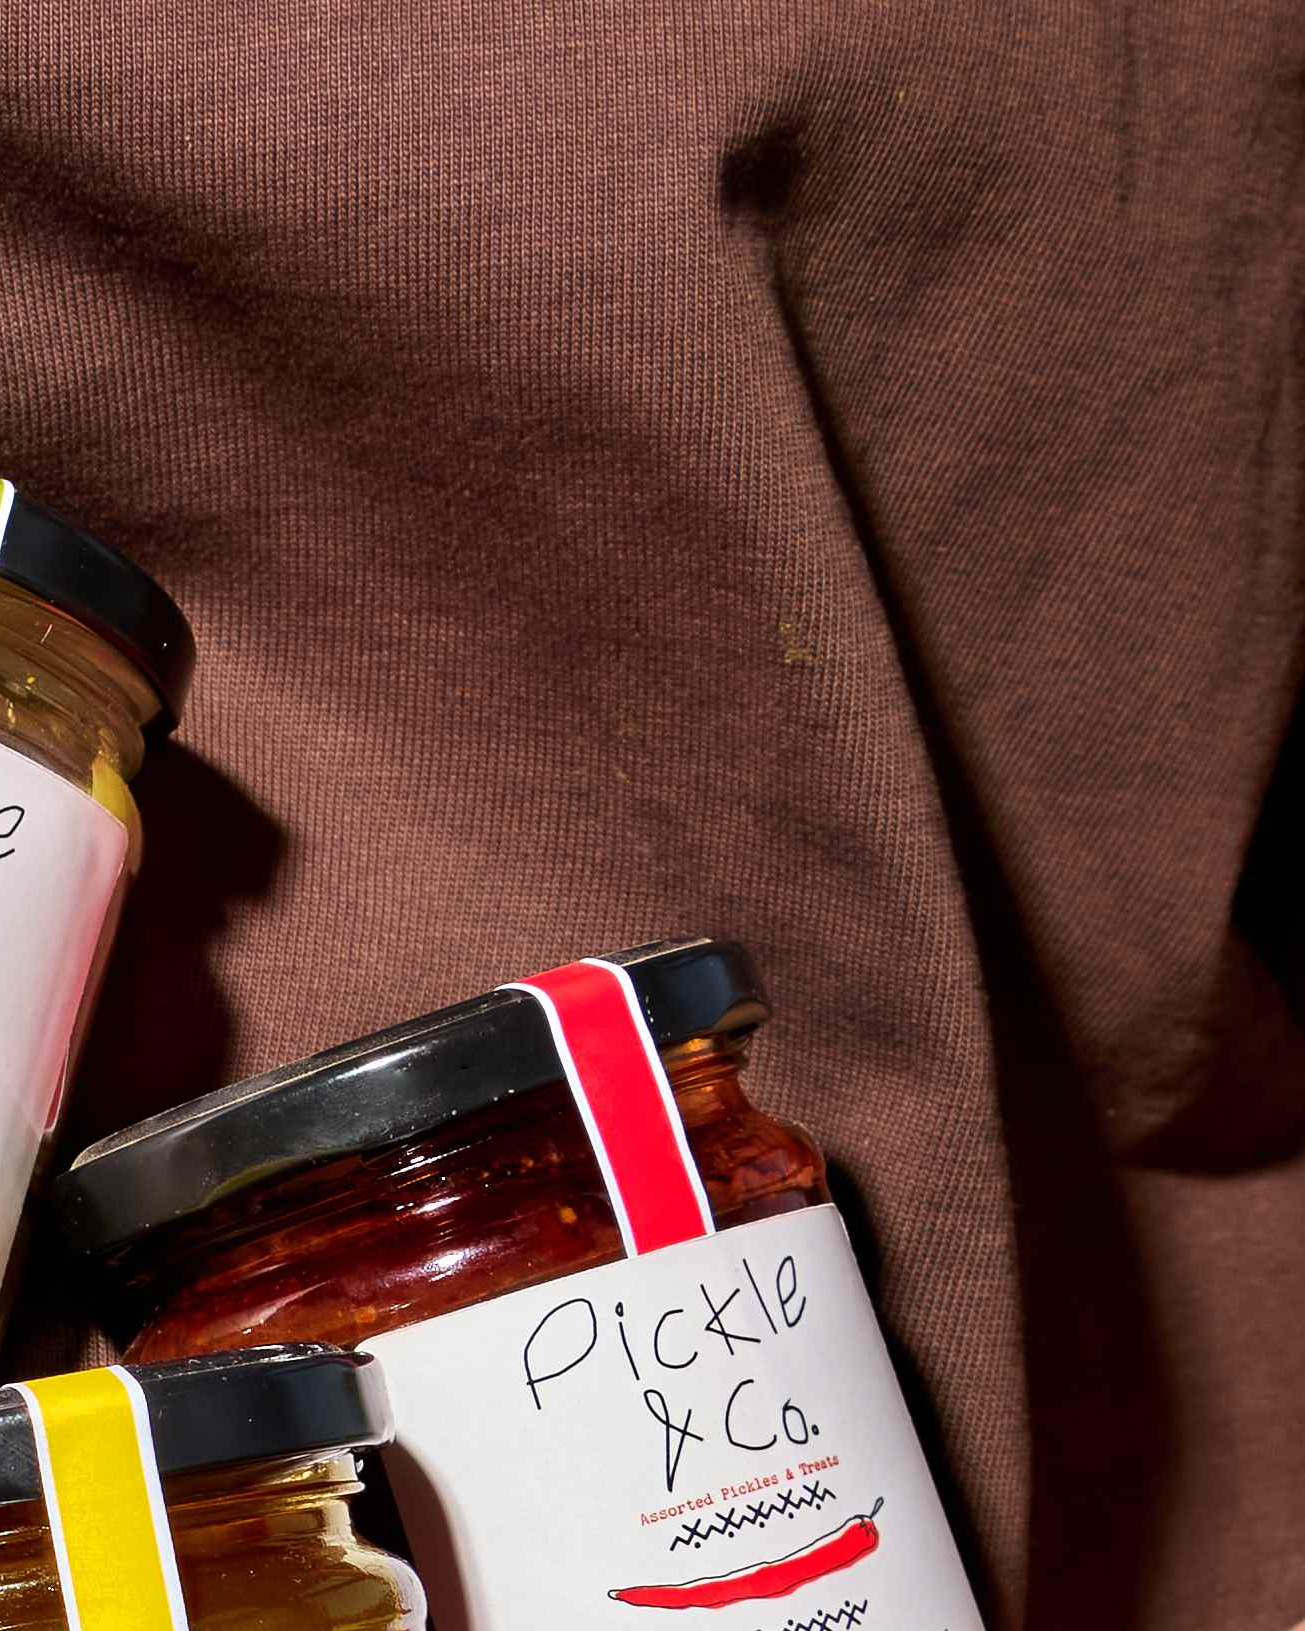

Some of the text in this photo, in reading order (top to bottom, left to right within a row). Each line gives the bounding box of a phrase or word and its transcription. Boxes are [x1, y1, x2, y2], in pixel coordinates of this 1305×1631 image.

[524, 1255, 806, 1409] Pickle
[640, 1455, 840, 1526] Assorted Pickles & Treats
[643, 1379, 819, 1492] & Co.
